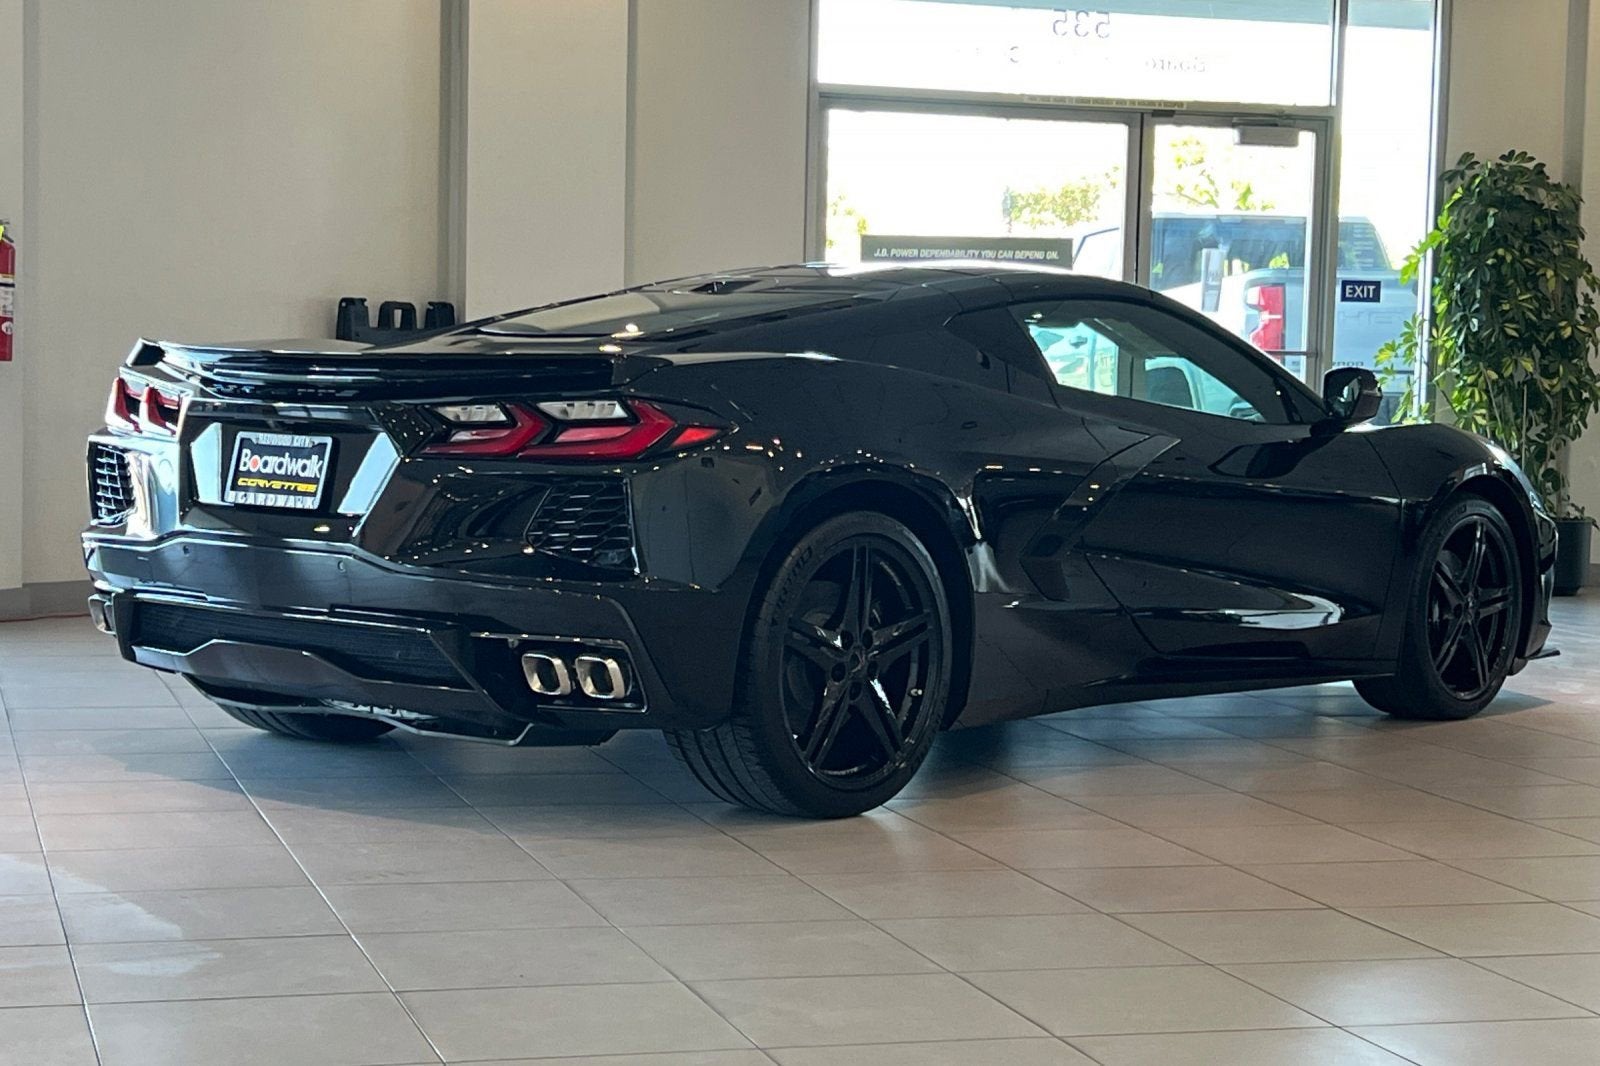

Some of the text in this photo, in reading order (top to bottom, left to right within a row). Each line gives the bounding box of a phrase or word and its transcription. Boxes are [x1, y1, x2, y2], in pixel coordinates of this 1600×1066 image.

[874, 248, 889, 257] J.D.
[890, 248, 919, 257] POWER
[920, 249, 980, 258] DEPENDABILITY
[981, 250, 997, 259] YOU
[997, 250, 1014, 259] CAN
[1014, 250, 1045, 260] DEPEND
[1345, 285, 1376, 298] EXIT
[239, 448, 323, 478] Boardwalk
